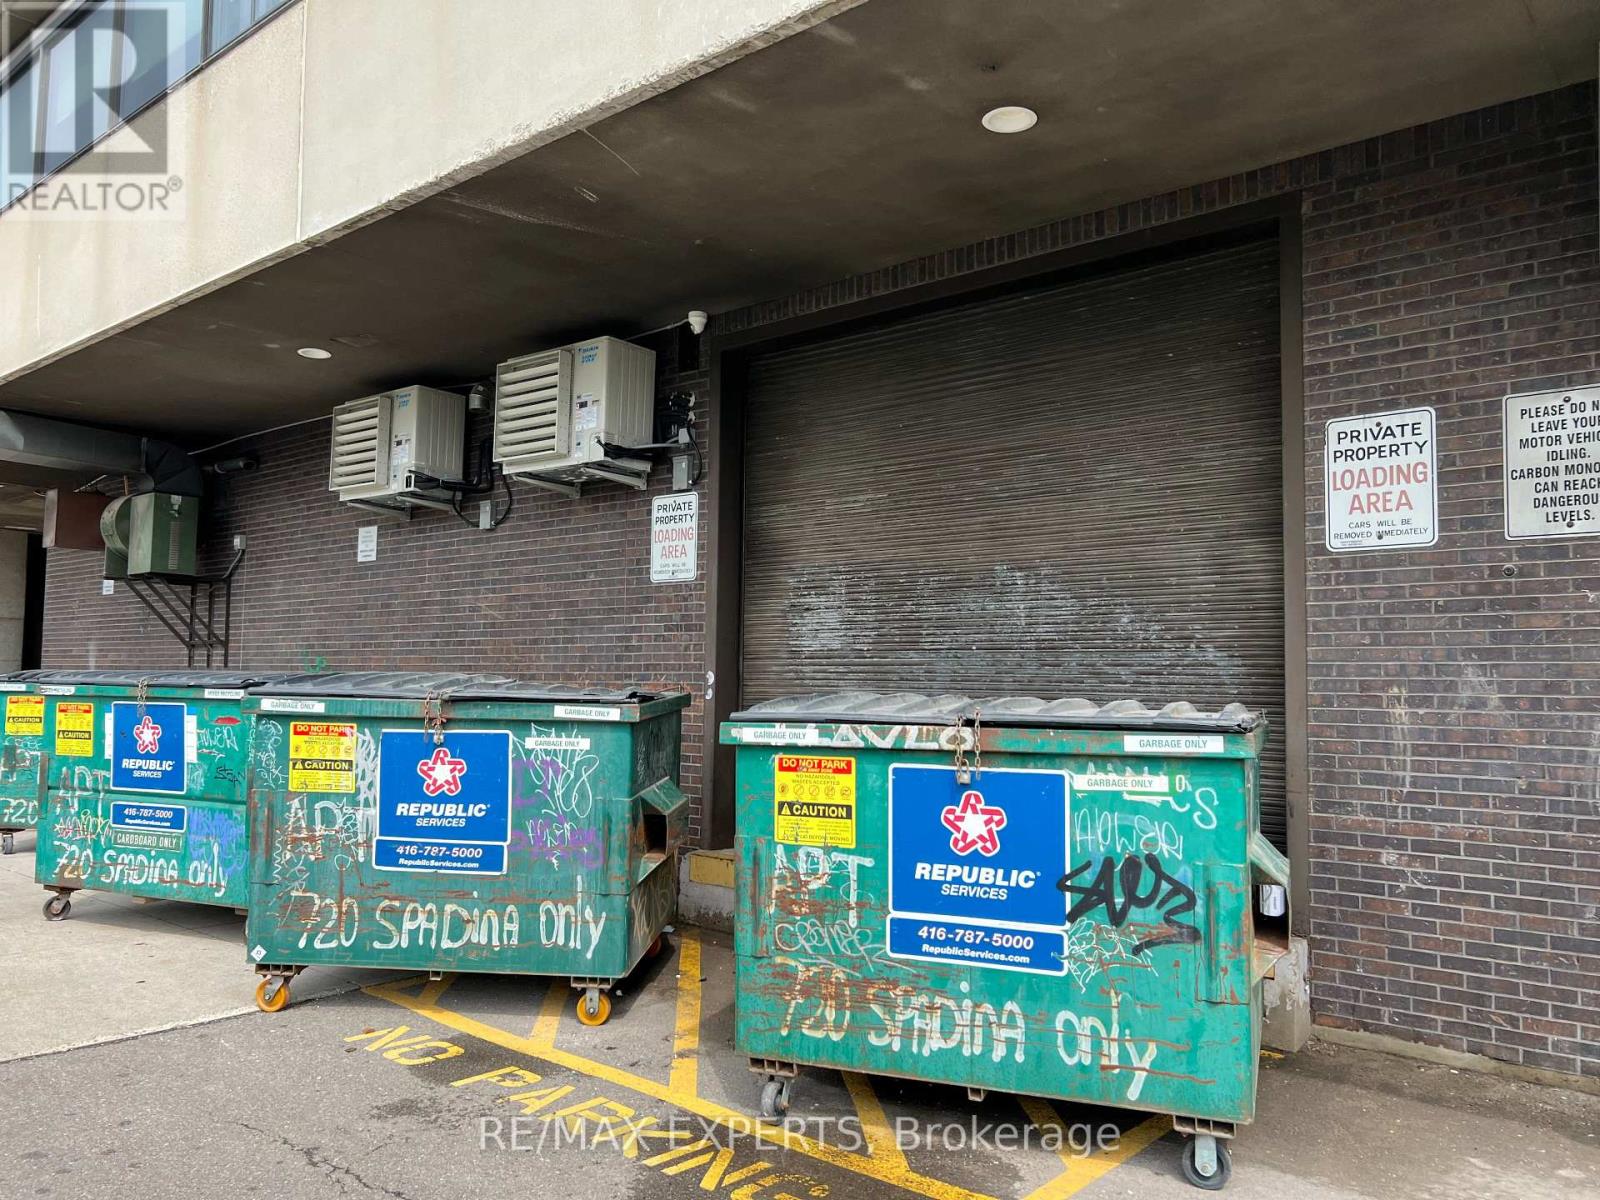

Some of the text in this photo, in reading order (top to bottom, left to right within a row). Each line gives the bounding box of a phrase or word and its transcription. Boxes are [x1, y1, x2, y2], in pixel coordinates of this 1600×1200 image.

[1520, 404, 1565, 419] PLEASE
[1570, 402, 1586, 414] DO
[1531, 418, 1568, 433] LEAVE
[1337, 421, 1423, 445] PRIVATE
[1519, 435, 1562, 449] MOTOR
[1333, 440, 1429, 463] PROPERTY
[1547, 447, 1591, 461] IDLING.
[1332, 461, 1429, 491] LOADING
[1510, 465, 1559, 480] CARBON
[1534, 481, 1559, 493] CAN
[656, 501, 694, 514] PRIVATE
[1348, 489, 1414, 515] AREA
[655, 512, 695, 526] PROPERTY
[1546, 509, 1596, 523] LEVELS.
[1348, 518, 1413, 529] CARS WILL BE
[654, 526, 695, 544] LOADING
[1333, 527, 1429, 540] REMOVED IMMEDIATELY
[660, 543, 688, 560] AREA
[564, 708, 593, 716] GARBAGE
[64, 731, 90, 739] CAUTION
[754, 730, 807, 740] GARBAGE ONLY
[1139, 739, 1209, 749] GARBAGE ONLY
[122, 758, 174, 771] REPUBLIC
[304, 760, 349, 770] CAUTION
[782, 758, 848, 769] DO NOT PARK
[132, 770, 162, 778] SERVICES
[1087, 778, 1153, 788] GARBAGE ONLY
[123, 808, 173, 818] 416-787-5000
[395, 803, 488, 818] REPUBLIC
[792, 804, 847, 818] CAUTION
[415, 818, 467, 827] SERVICES
[159, 836, 177, 848] ONLY
[396, 845, 483, 858] 416-787-5000
[52, 840, 93, 879] 720
[398, 858, 480, 869] RepublicServices.com
[914, 862, 1036, 889] REPUBLIC
[940, 883, 1009, 900] SERVICES
[290, 889, 359, 950] 720
[917, 925, 1035, 950] 416-787-5000
[921, 943, 1031, 964] RepublicServices.com
[774, 956, 850, 1041] 720
[343, 1025, 831, 1200] NO PARKING
